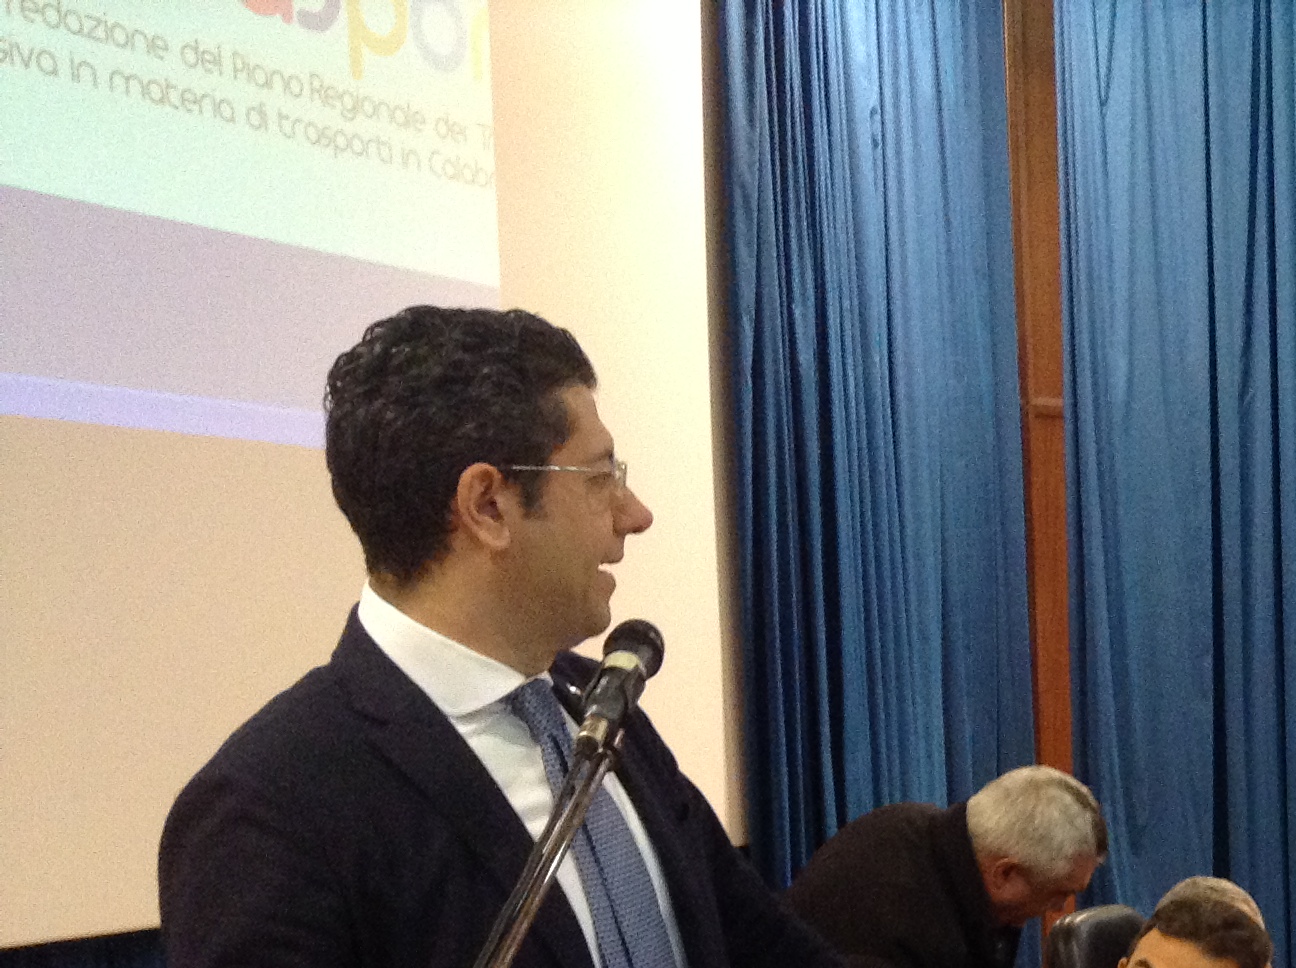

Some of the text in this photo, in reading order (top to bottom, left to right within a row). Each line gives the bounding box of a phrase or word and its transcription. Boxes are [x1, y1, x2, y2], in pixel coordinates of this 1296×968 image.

[4, 0, 169, 62] redazione
[180, 38, 224, 78] del
[232, 51, 304, 99] Piano
[308, 73, 427, 133] Regionale
[435, 114, 467, 144] dei
[69, 49, 99, 90] in
[108, 68, 236, 124] materia
[246, 100, 268, 133] di
[277, 107, 394, 165] trasporti
[400, 146, 422, 173] in
